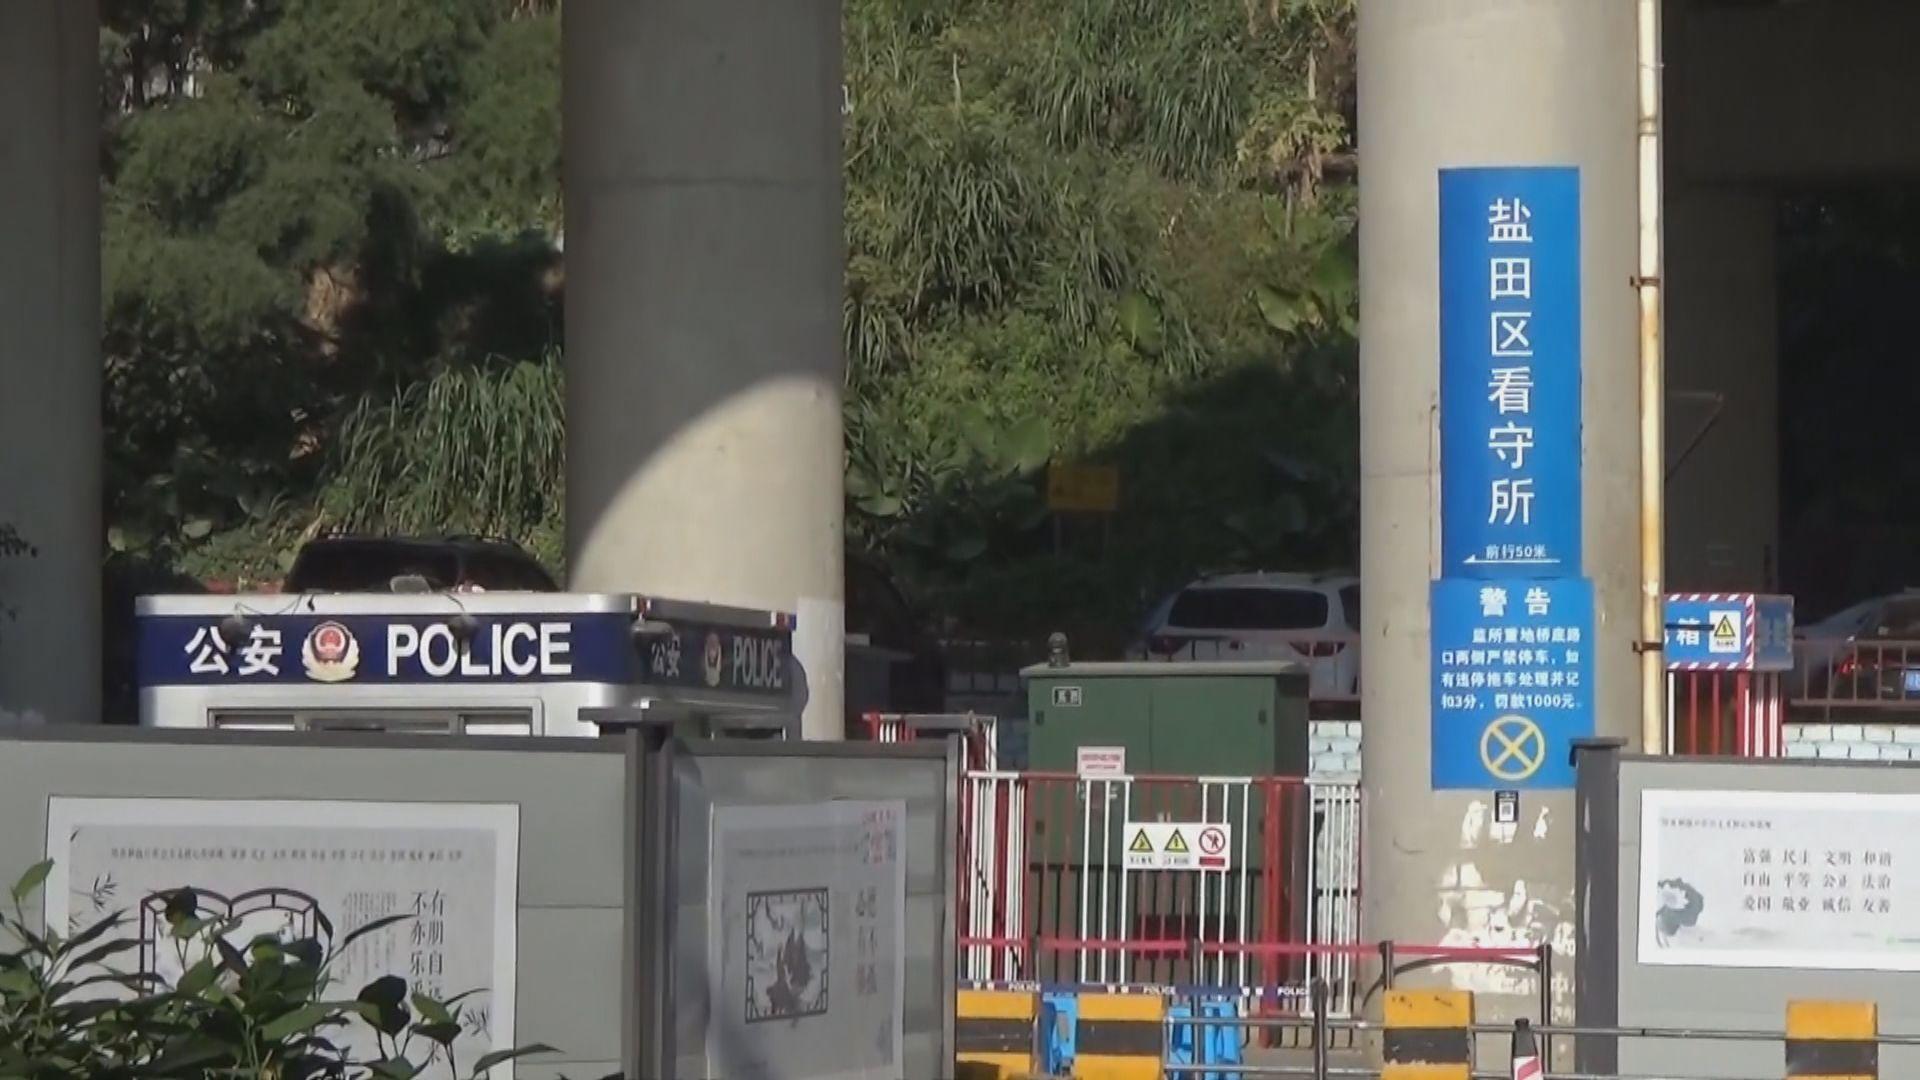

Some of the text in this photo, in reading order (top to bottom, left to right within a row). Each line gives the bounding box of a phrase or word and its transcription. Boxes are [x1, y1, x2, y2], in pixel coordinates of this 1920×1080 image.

[1487, 197, 1535, 525] 盐田区看守所
[1485, 544, 1547, 560] 前行50米
[184, 625, 283, 676] 公安
[386, 623, 573, 678] POLICE
[652, 636, 681, 678] 公安
[732, 636, 783, 688] POLICE
